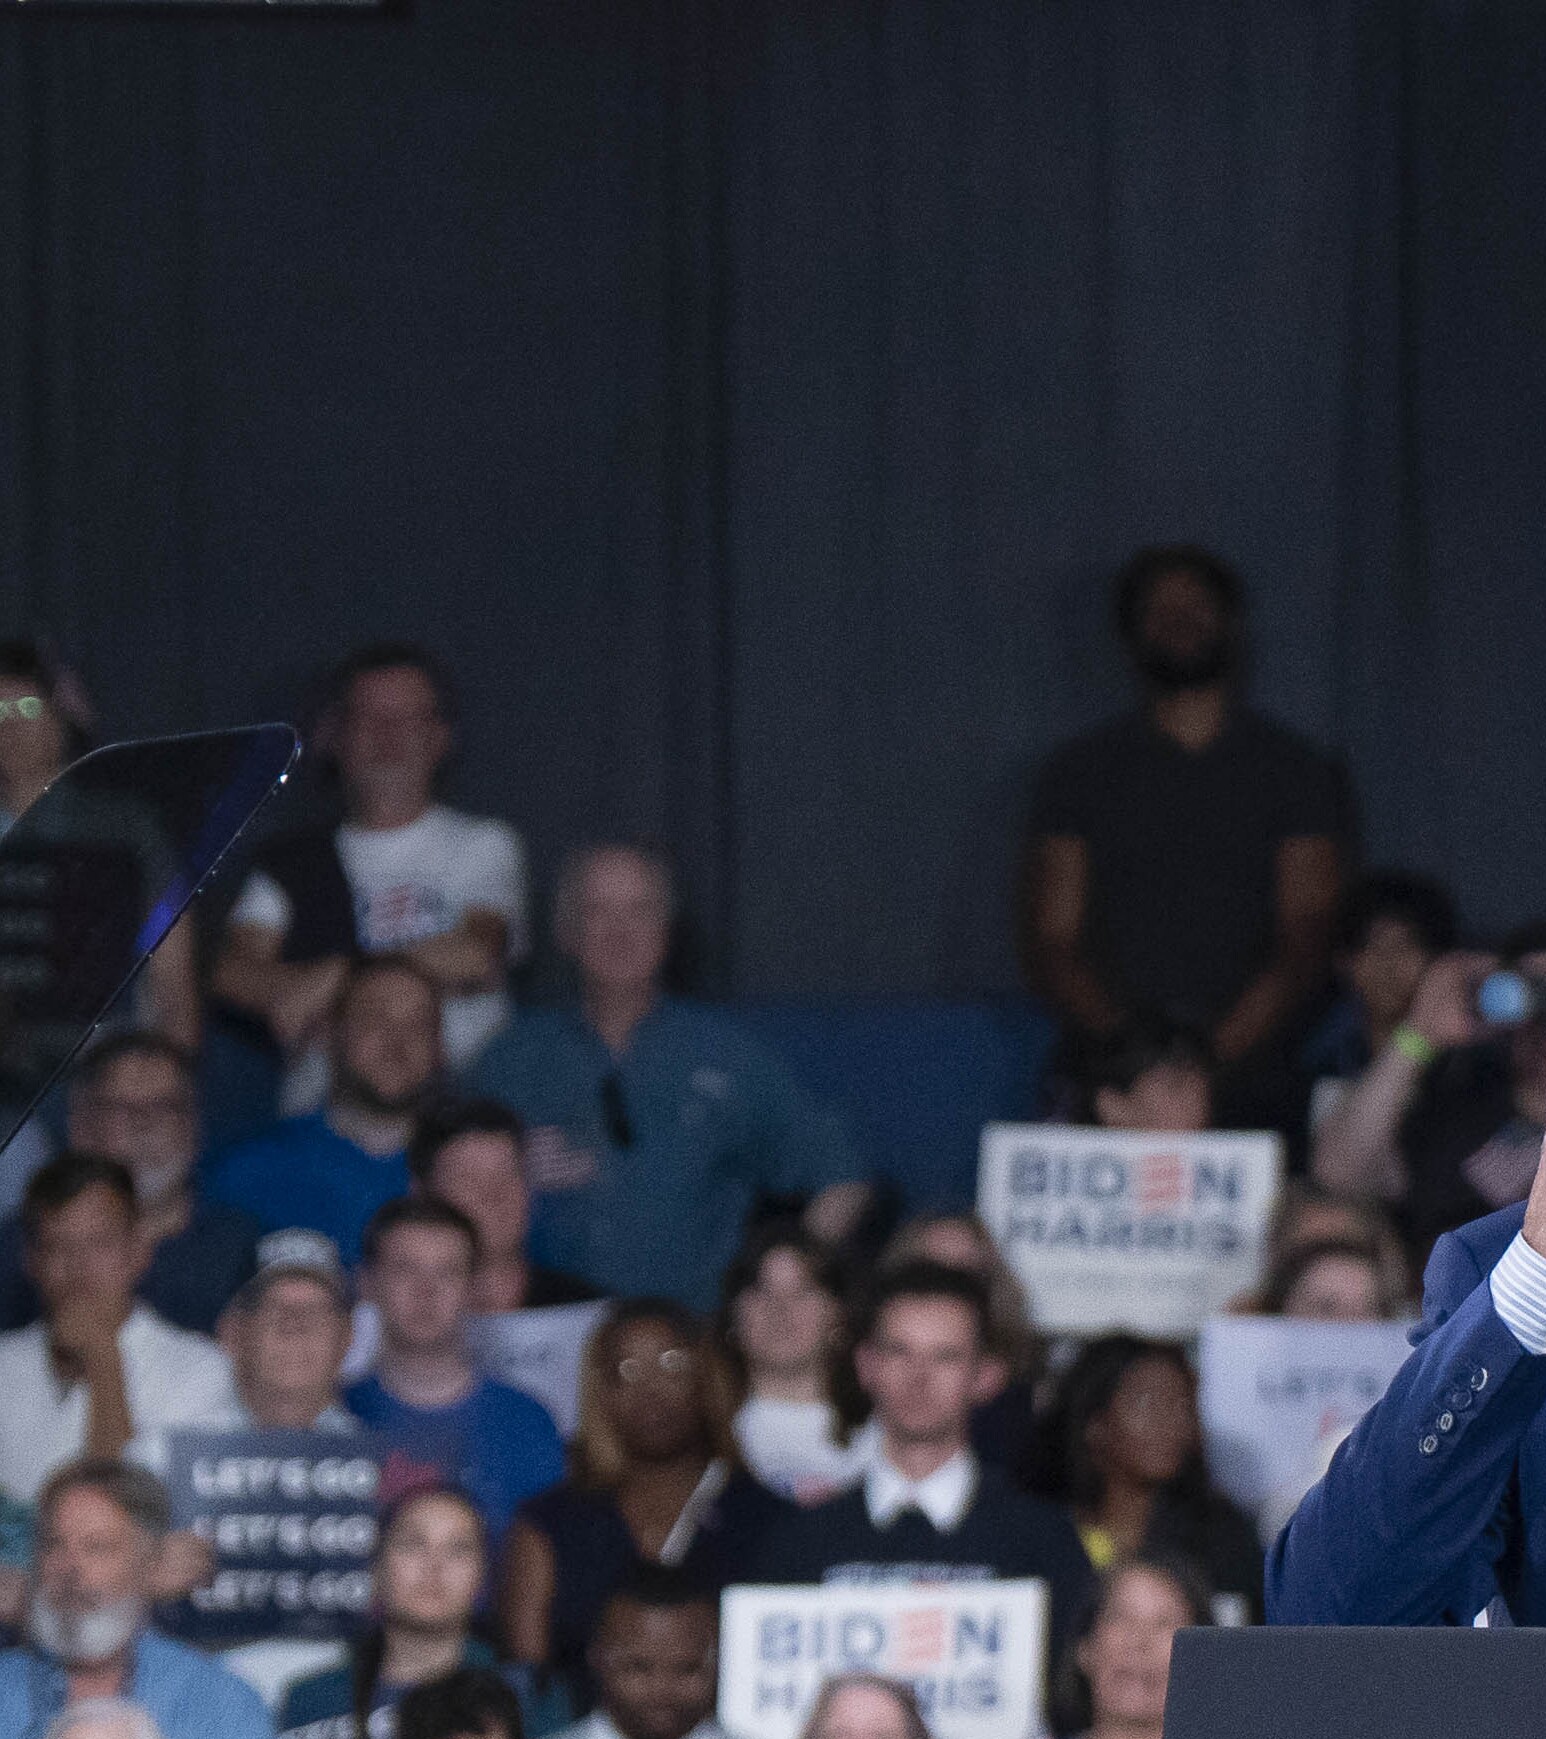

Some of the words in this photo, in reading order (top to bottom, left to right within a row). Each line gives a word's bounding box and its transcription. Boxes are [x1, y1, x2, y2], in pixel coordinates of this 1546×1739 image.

[1007, 1148, 1241, 1208] BIDEN
[1003, 1211, 1242, 1259] HARRIS
[759, 1609, 1004, 1666] BIDEN
